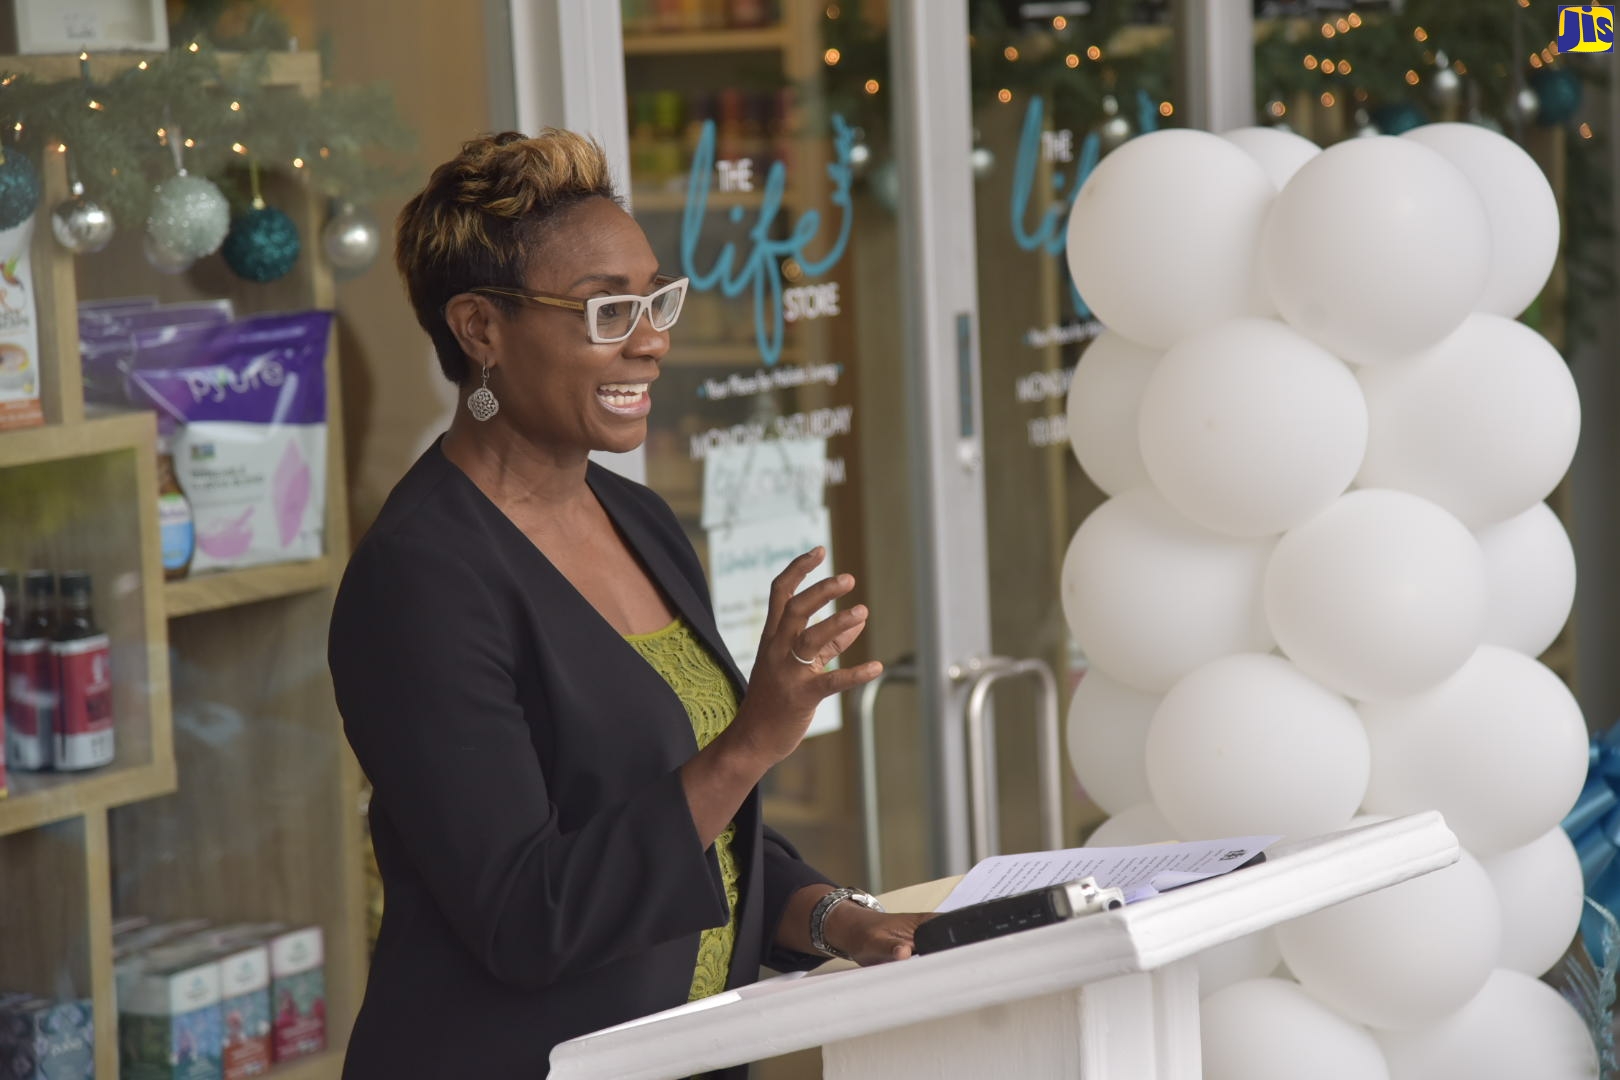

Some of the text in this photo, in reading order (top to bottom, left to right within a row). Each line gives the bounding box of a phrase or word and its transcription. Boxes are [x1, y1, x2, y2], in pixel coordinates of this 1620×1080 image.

[1041, 129, 1072, 162] THE
[715, 158, 753, 192] THE
[680, 118, 852, 366] life
[783, 281, 840, 321] STORE
